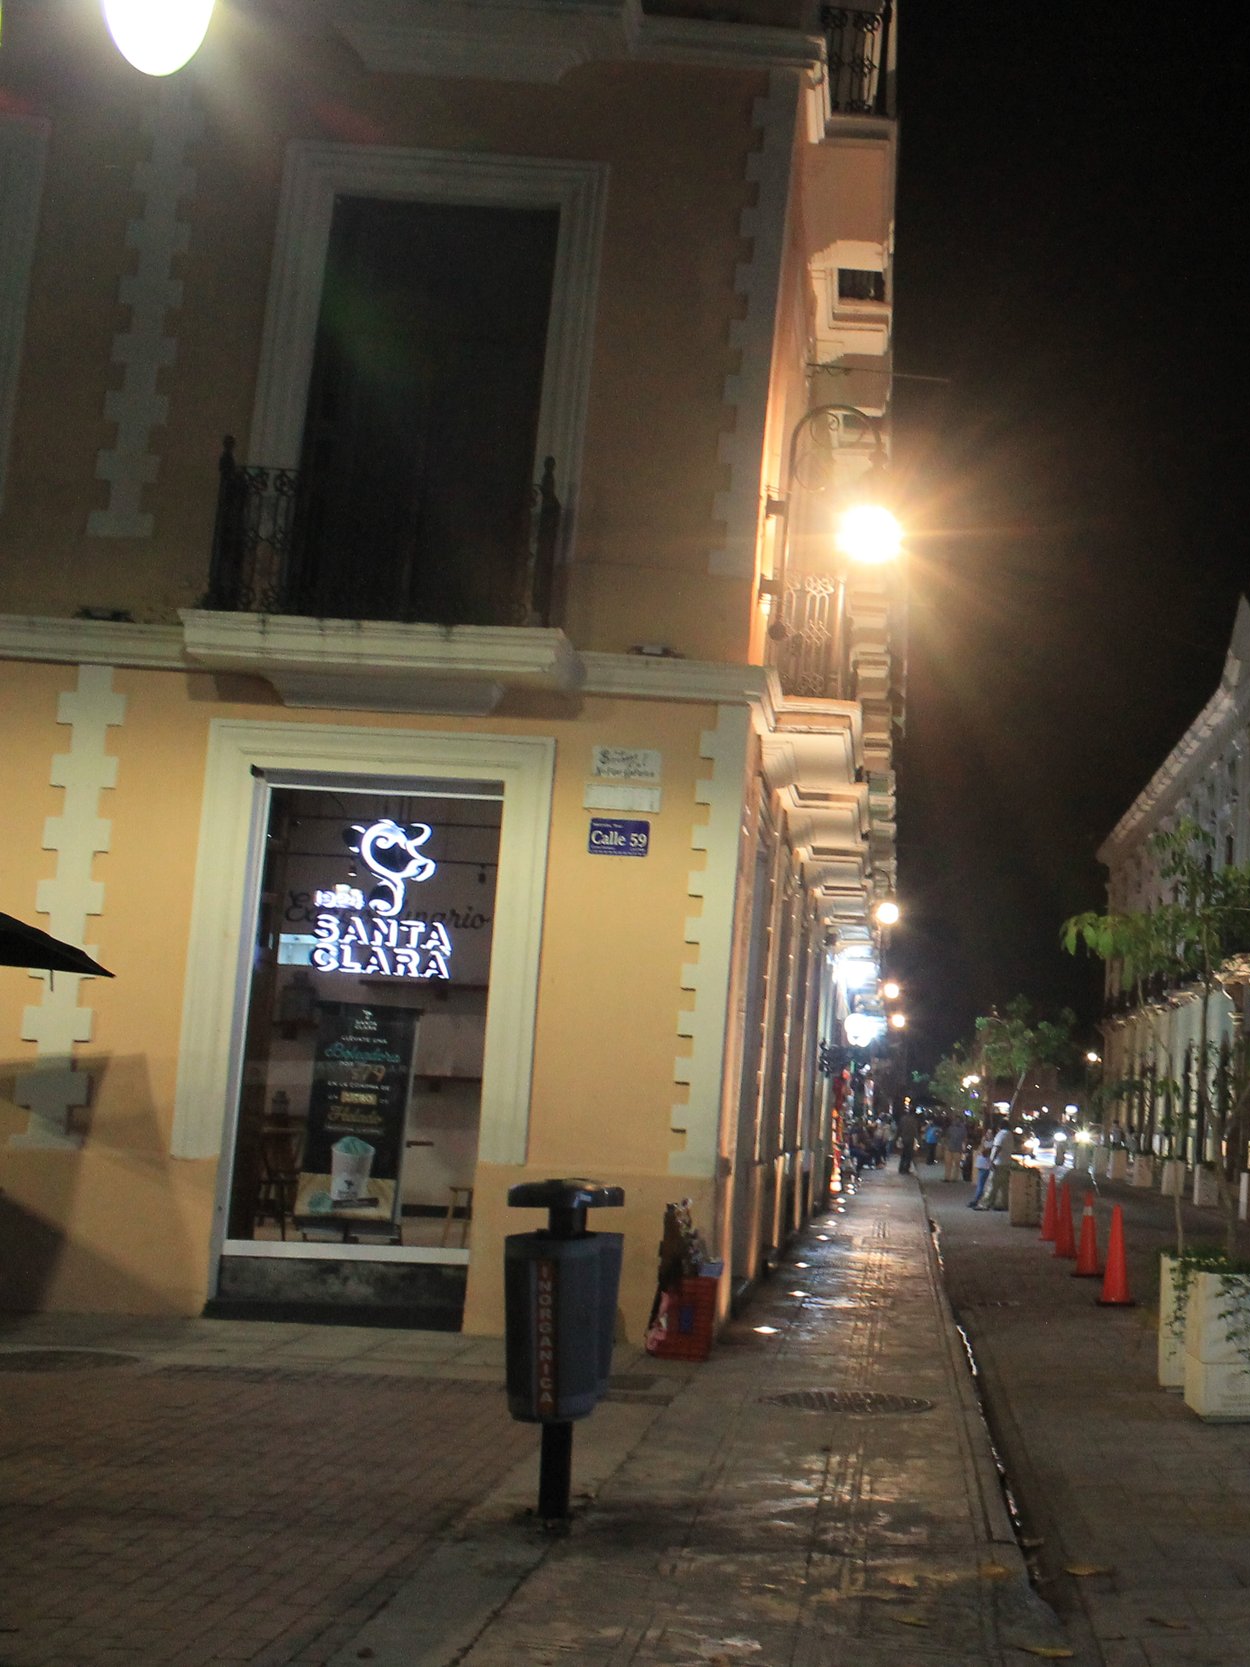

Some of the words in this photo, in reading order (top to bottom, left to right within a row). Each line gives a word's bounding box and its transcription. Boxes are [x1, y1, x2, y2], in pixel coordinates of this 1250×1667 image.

[591, 830, 627, 846] Calle
[629, 833, 648, 848] 59
[314, 913, 452, 956] SANTA
[313, 942, 451, 980] CLARA
[538, 1263, 554, 1404] INORGANICA
